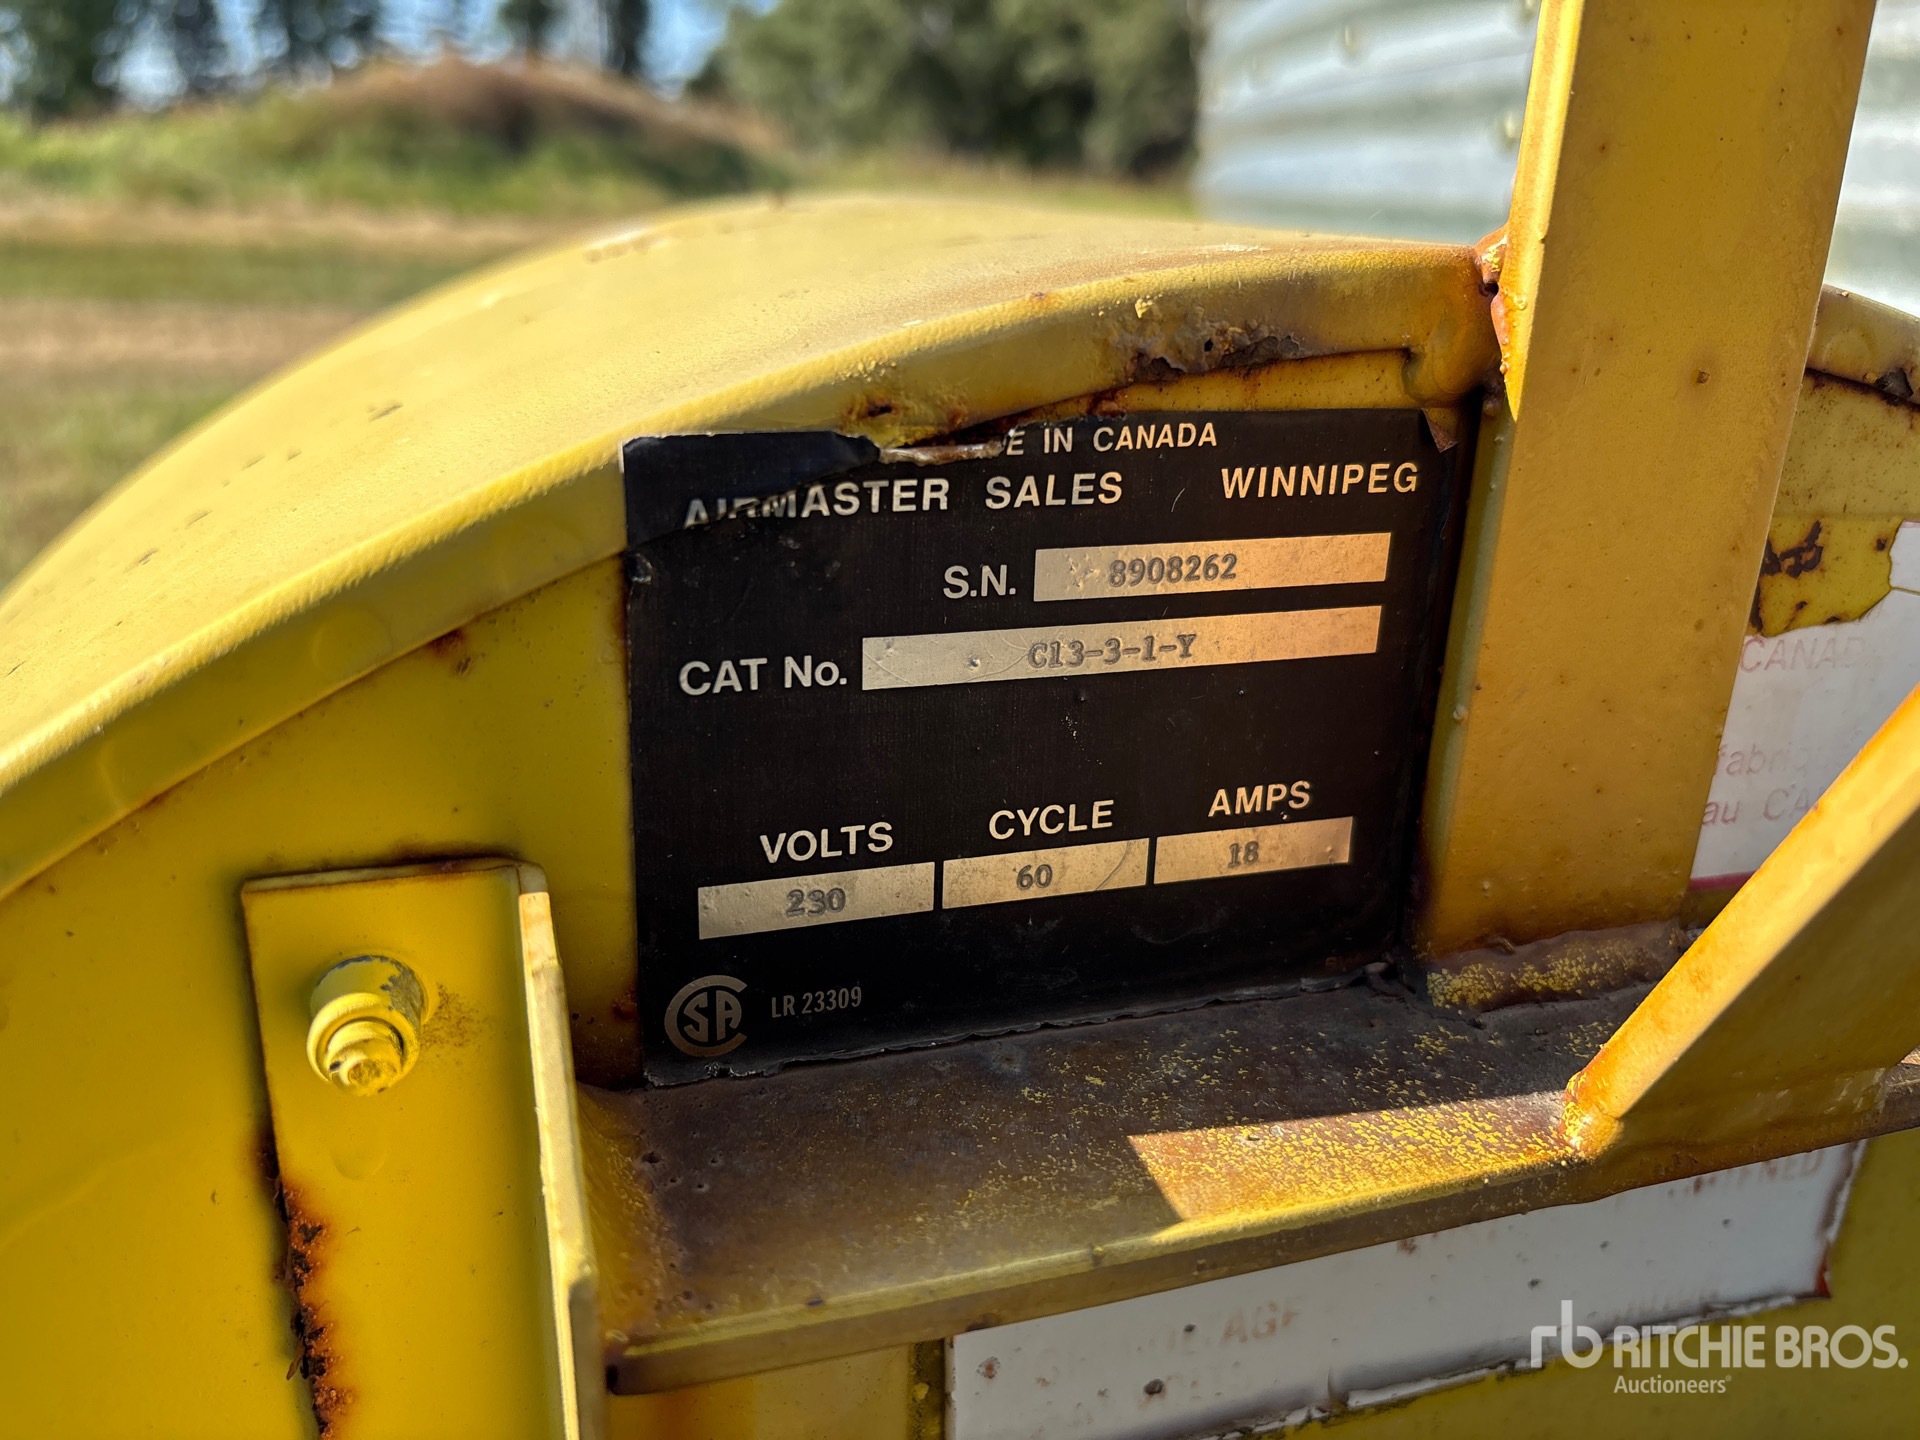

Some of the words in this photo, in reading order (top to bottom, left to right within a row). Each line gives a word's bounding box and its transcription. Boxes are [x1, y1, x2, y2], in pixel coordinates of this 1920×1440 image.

[1043, 426, 1073, 454] IN
[1092, 421, 1218, 452] CANADA
[985, 471, 1124, 510] SALES
[1221, 462, 1420, 500] WINNIPEG
[943, 564, 1017, 599] S.N.
[1108, 553, 1238, 588] 8908262
[678, 656, 768, 696] CAT
[784, 655, 848, 689] No.
[1027, 633, 1197, 669] C13-3-1-Y
[1207, 780, 1312, 818] AMPS
[988, 799, 1115, 841] CYCLE
[759, 821, 895, 864] VOLTS
[1227, 840, 1261, 870] 18
[1015, 863, 1054, 891] 60
[785, 886, 847, 919] 230
[770, 995, 796, 1019] LR
[801, 985, 863, 1015] 23309
